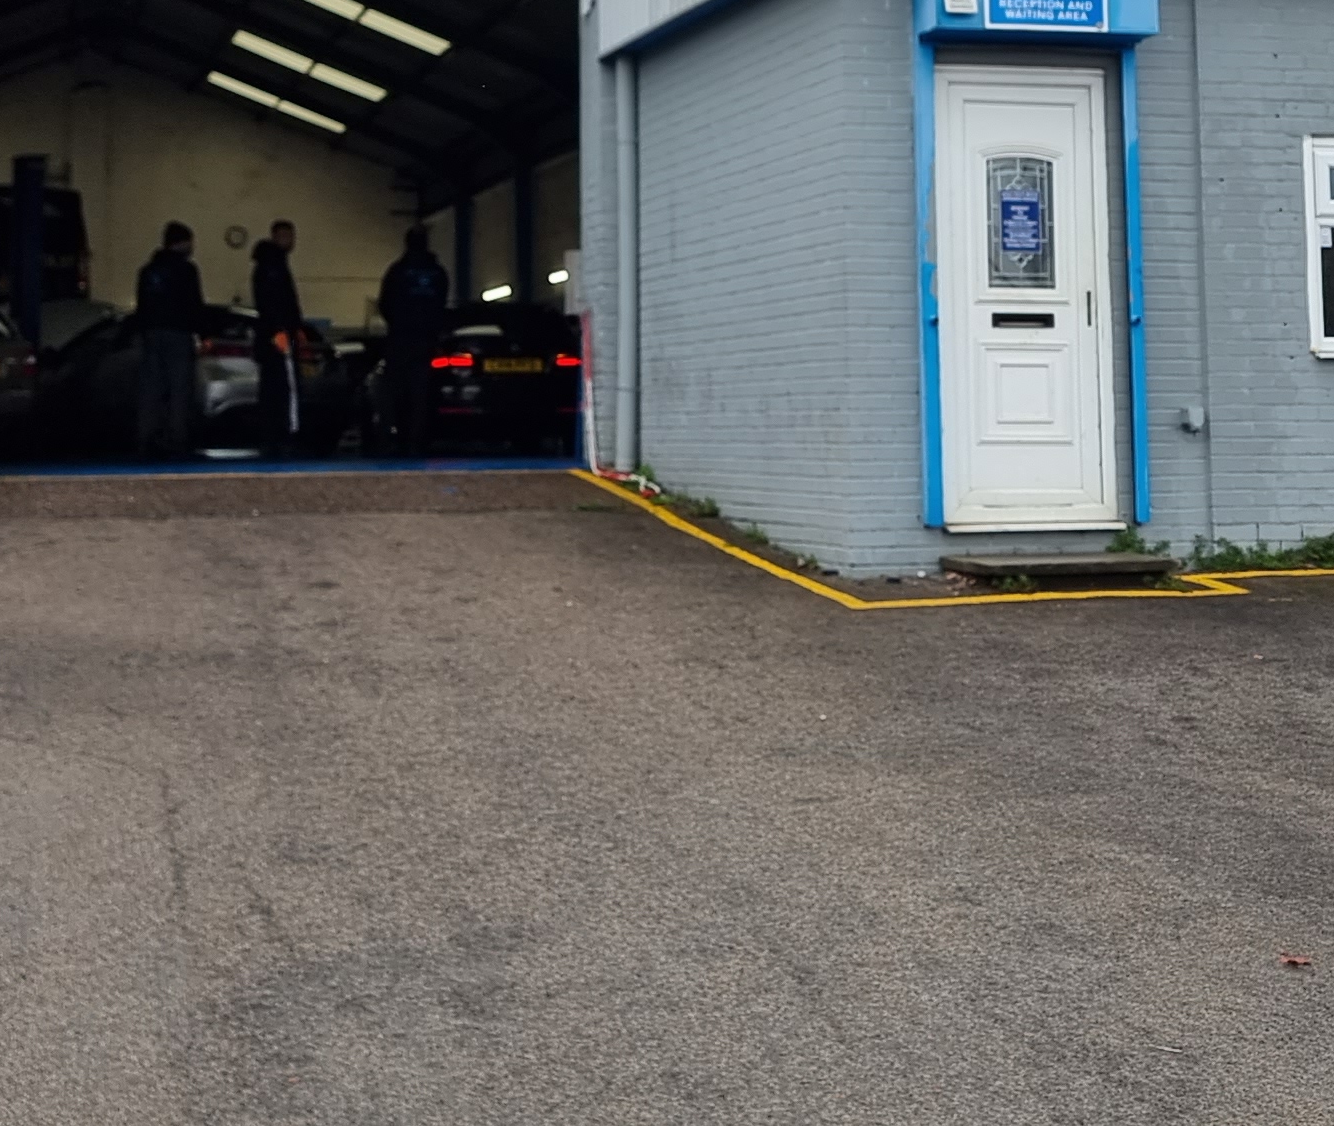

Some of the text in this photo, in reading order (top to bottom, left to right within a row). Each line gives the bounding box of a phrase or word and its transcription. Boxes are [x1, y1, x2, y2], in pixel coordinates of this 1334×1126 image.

[1068, 0, 1093, 12] AND
[1005, 9, 1088, 21] WAITING AREA
